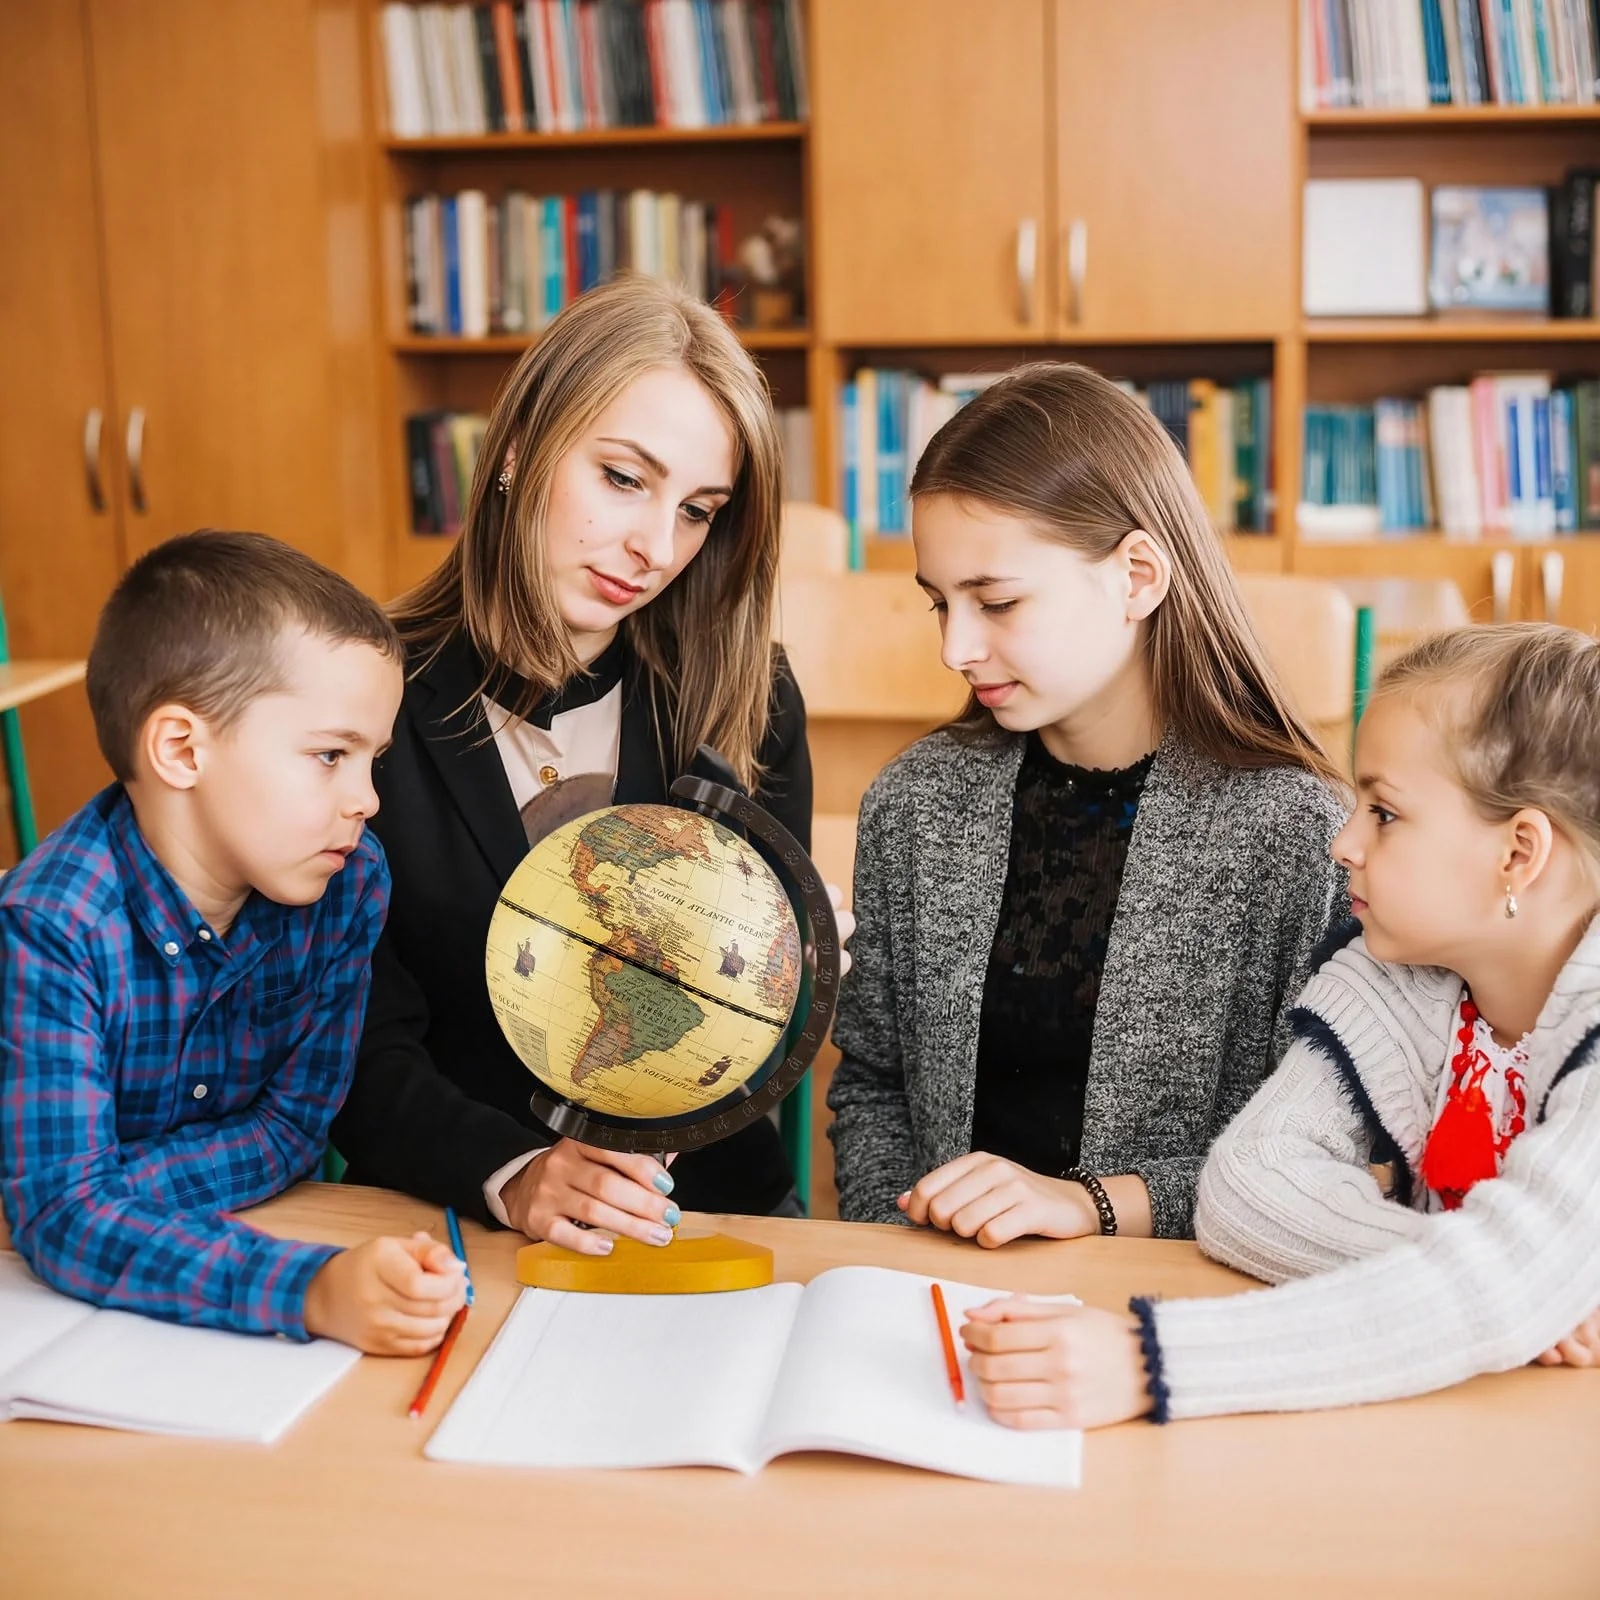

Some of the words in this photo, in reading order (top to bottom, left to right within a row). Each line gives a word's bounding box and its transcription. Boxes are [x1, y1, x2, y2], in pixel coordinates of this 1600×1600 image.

[650, 887, 685, 906] NORTH
[687, 903, 735, 926] ATLANTIC
[737, 923, 764, 939] OCEAN
[820, 967, 833, 985] 20
[604, 985, 631, 1002] SOUTH
[639, 1003, 677, 1024] AMERICA
[636, 1010, 667, 1026] BRAZIL
[643, 1067, 674, 1084] SOUTH
